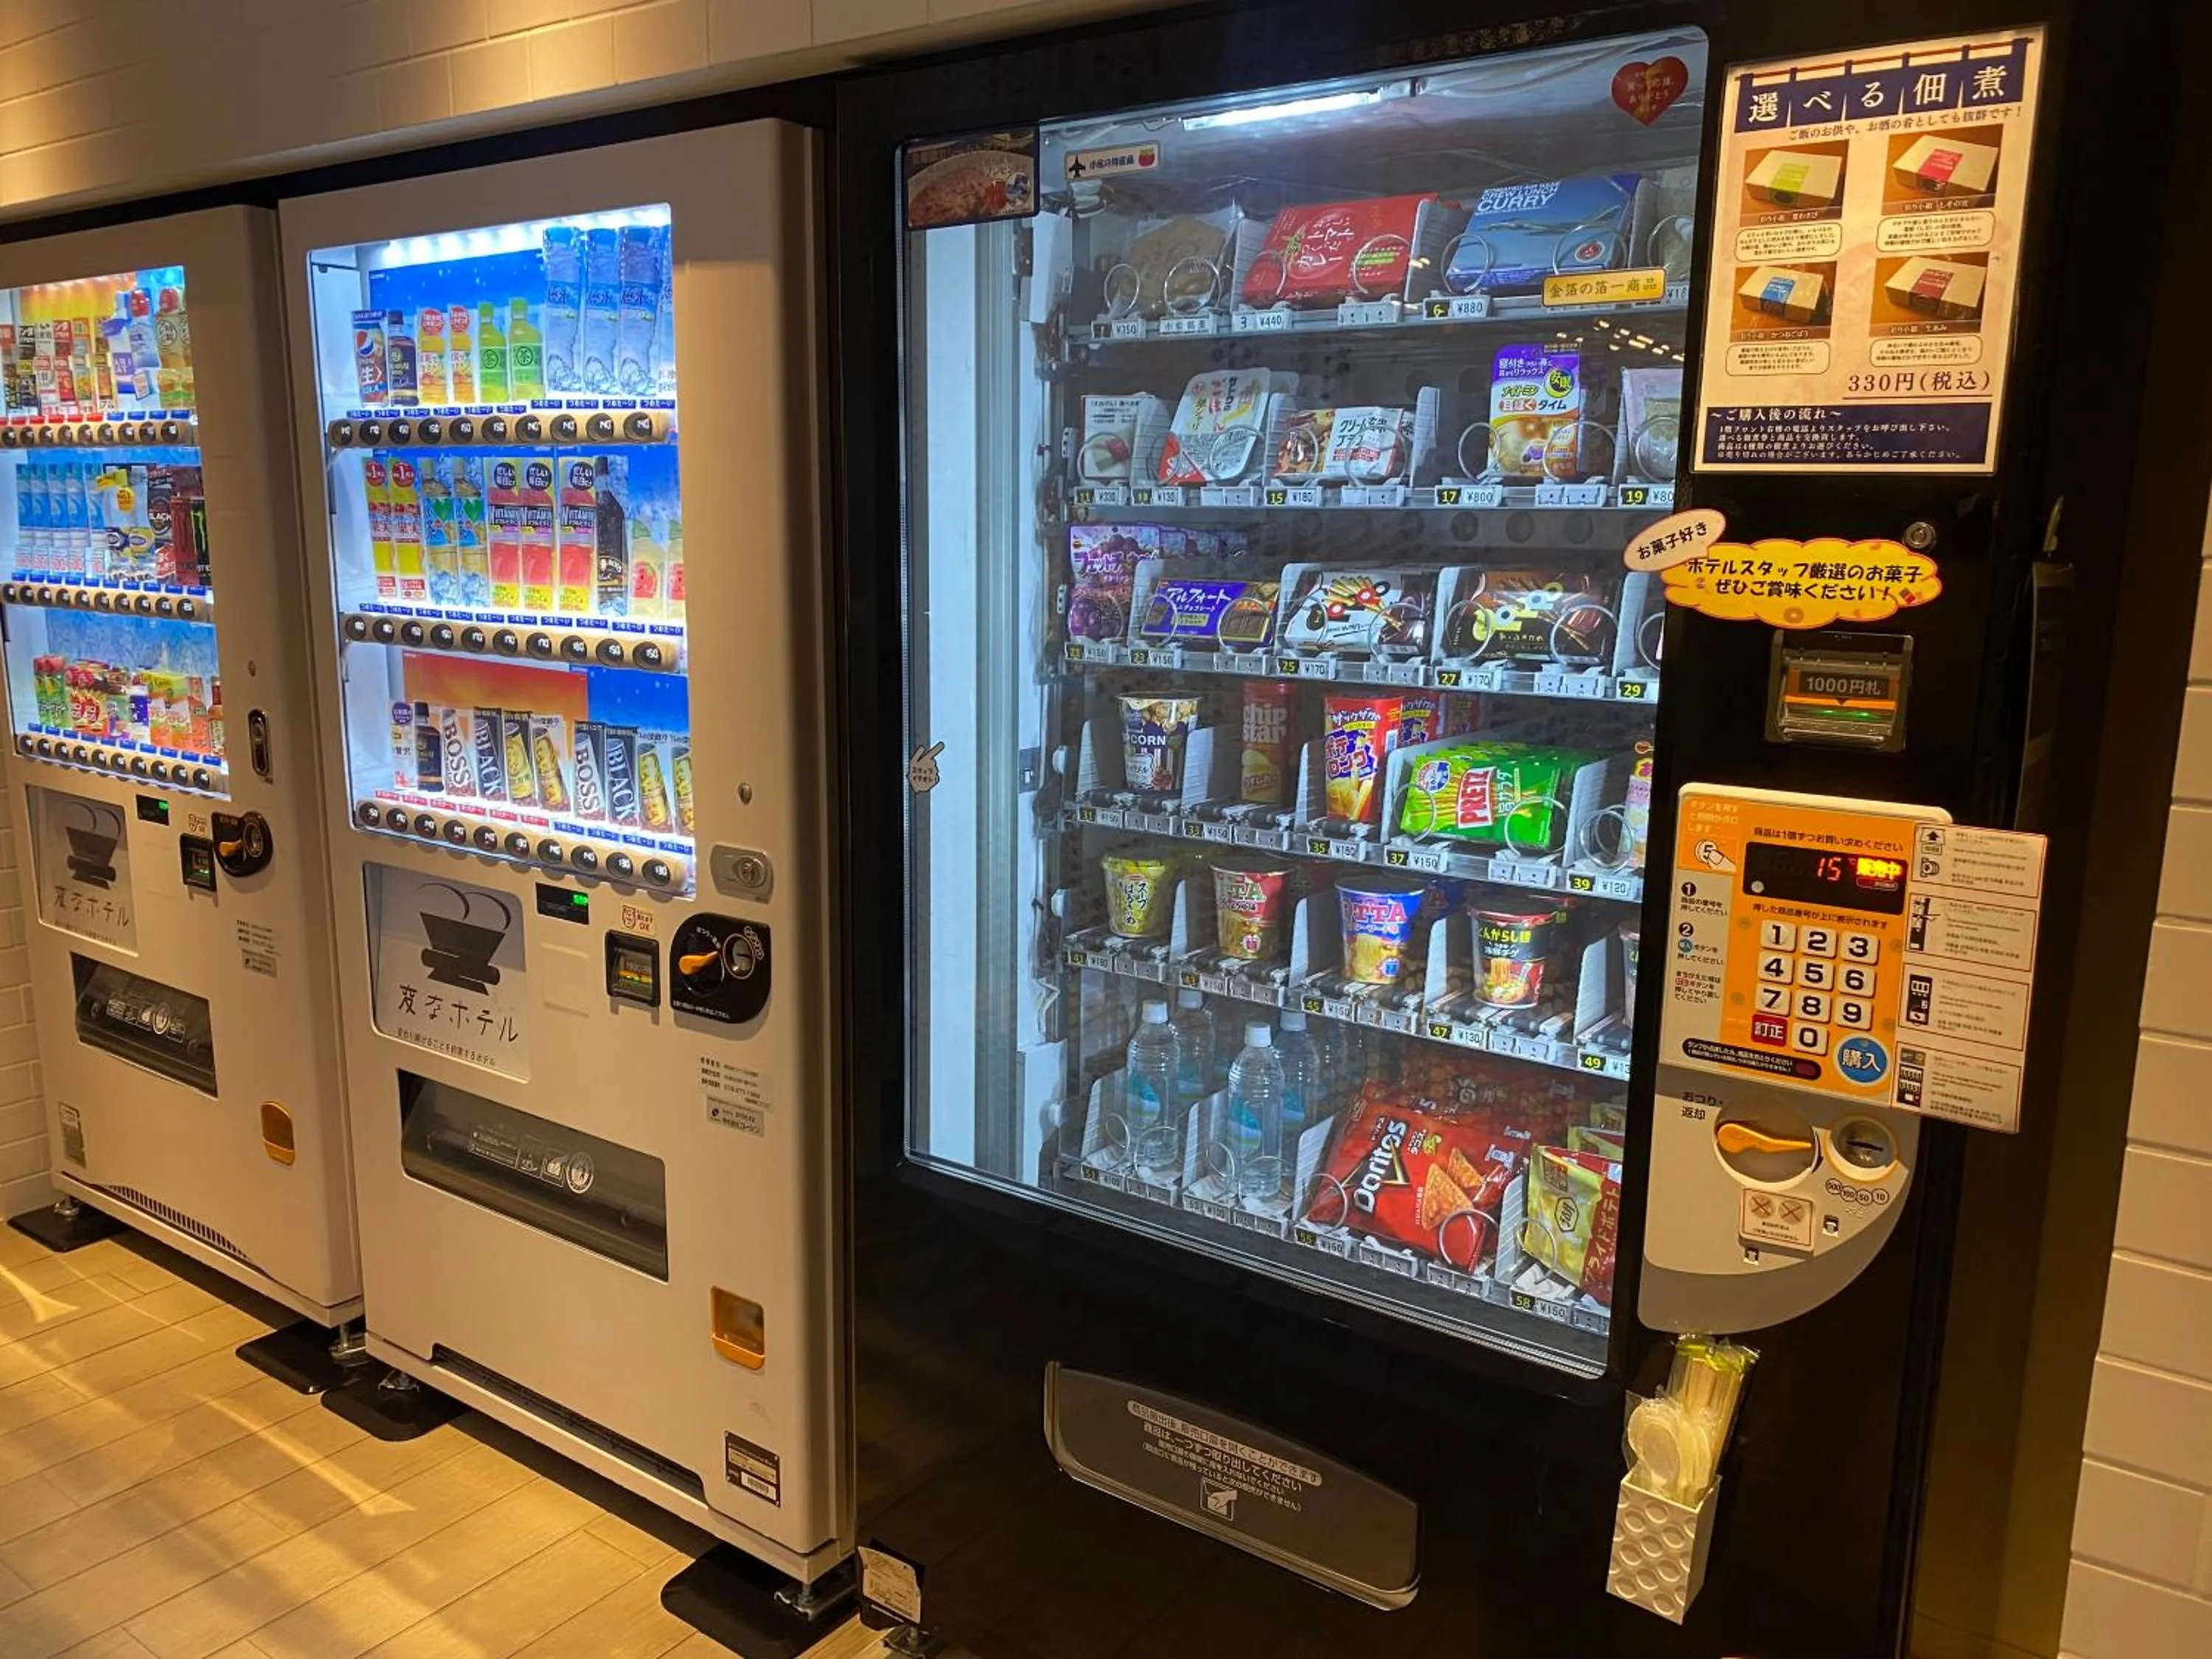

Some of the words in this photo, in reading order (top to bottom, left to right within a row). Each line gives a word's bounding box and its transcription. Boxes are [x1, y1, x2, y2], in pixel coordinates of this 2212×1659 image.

[1748, 66, 2007, 123] 選べる佃煮
[1478, 192, 1555, 212] CURRY
[1550, 277, 1658, 299] 金箔の箔一商品
[1457, 301, 1484, 314] ¥880
[362, 366, 375, 384] 生
[1270, 491, 1284, 504] 15
[1441, 491, 1456, 503] 17
[1467, 491, 1494, 502] ¥800
[1626, 491, 1643, 503] 19
[1638, 522, 1708, 560] お菓子好き
[1687, 559, 1923, 583] ホテルスタッフ厳選のお菓子
[1166, 588, 1231, 605] アルフォート
[1715, 579, 1891, 601] ぜひご賞味ください！
[1282, 661, 1295, 672] 25
[1304, 663, 1325, 675] ¥170
[1441, 673, 1456, 684] 27
[1624, 684, 1641, 697] 29
[1806, 678, 1882, 696] 1000円札
[1243, 703, 1287, 728] chip
[1243, 723, 1286, 745] star
[444, 723, 470, 785] BOSS
[476, 722, 502, 796] BLACK
[576, 748, 599, 811] BOSS
[608, 745, 635, 820] BLACK
[1459, 770, 1490, 824] PRETZ
[1312, 841, 1326, 852] 35
[1391, 852, 1404, 864] 37
[1413, 855, 1437, 869] ¥150
[1817, 858, 1842, 881] 15
[1573, 877, 1590, 891] 39
[1603, 880, 1627, 894] ¥120
[1772, 924, 1784, 945] 1
[1808, 931, 1827, 952] 2
[1848, 936, 1869, 958] 3
[1764, 958, 1784, 977] 4
[1805, 963, 1824, 984] 5
[1845, 970, 1865, 991] 6
[400, 984, 518, 1043] 変なホテル
[1307, 1000, 1321, 1011] 45
[1763, 989, 1782, 1008] 7
[1801, 995, 1821, 1017] 8
[1843, 1002, 1863, 1023] 9
[1433, 1025, 1447, 1037] 47
[1458, 1031, 1481, 1043] ¥130
[1754, 1020, 1784, 1040] 訂正
[1799, 1027, 1818, 1048] 0
[1585, 1056, 1601, 1068] 49
[1841, 1048, 1882, 1074] 購入
[1682, 1107, 1706, 1120] 返却
[1858, 1193, 1870, 1202] 50
[1875, 1192, 1886, 1201] 10
[1514, 1295, 1531, 1309] 58
[1540, 1301, 1567, 1319] ¥150
